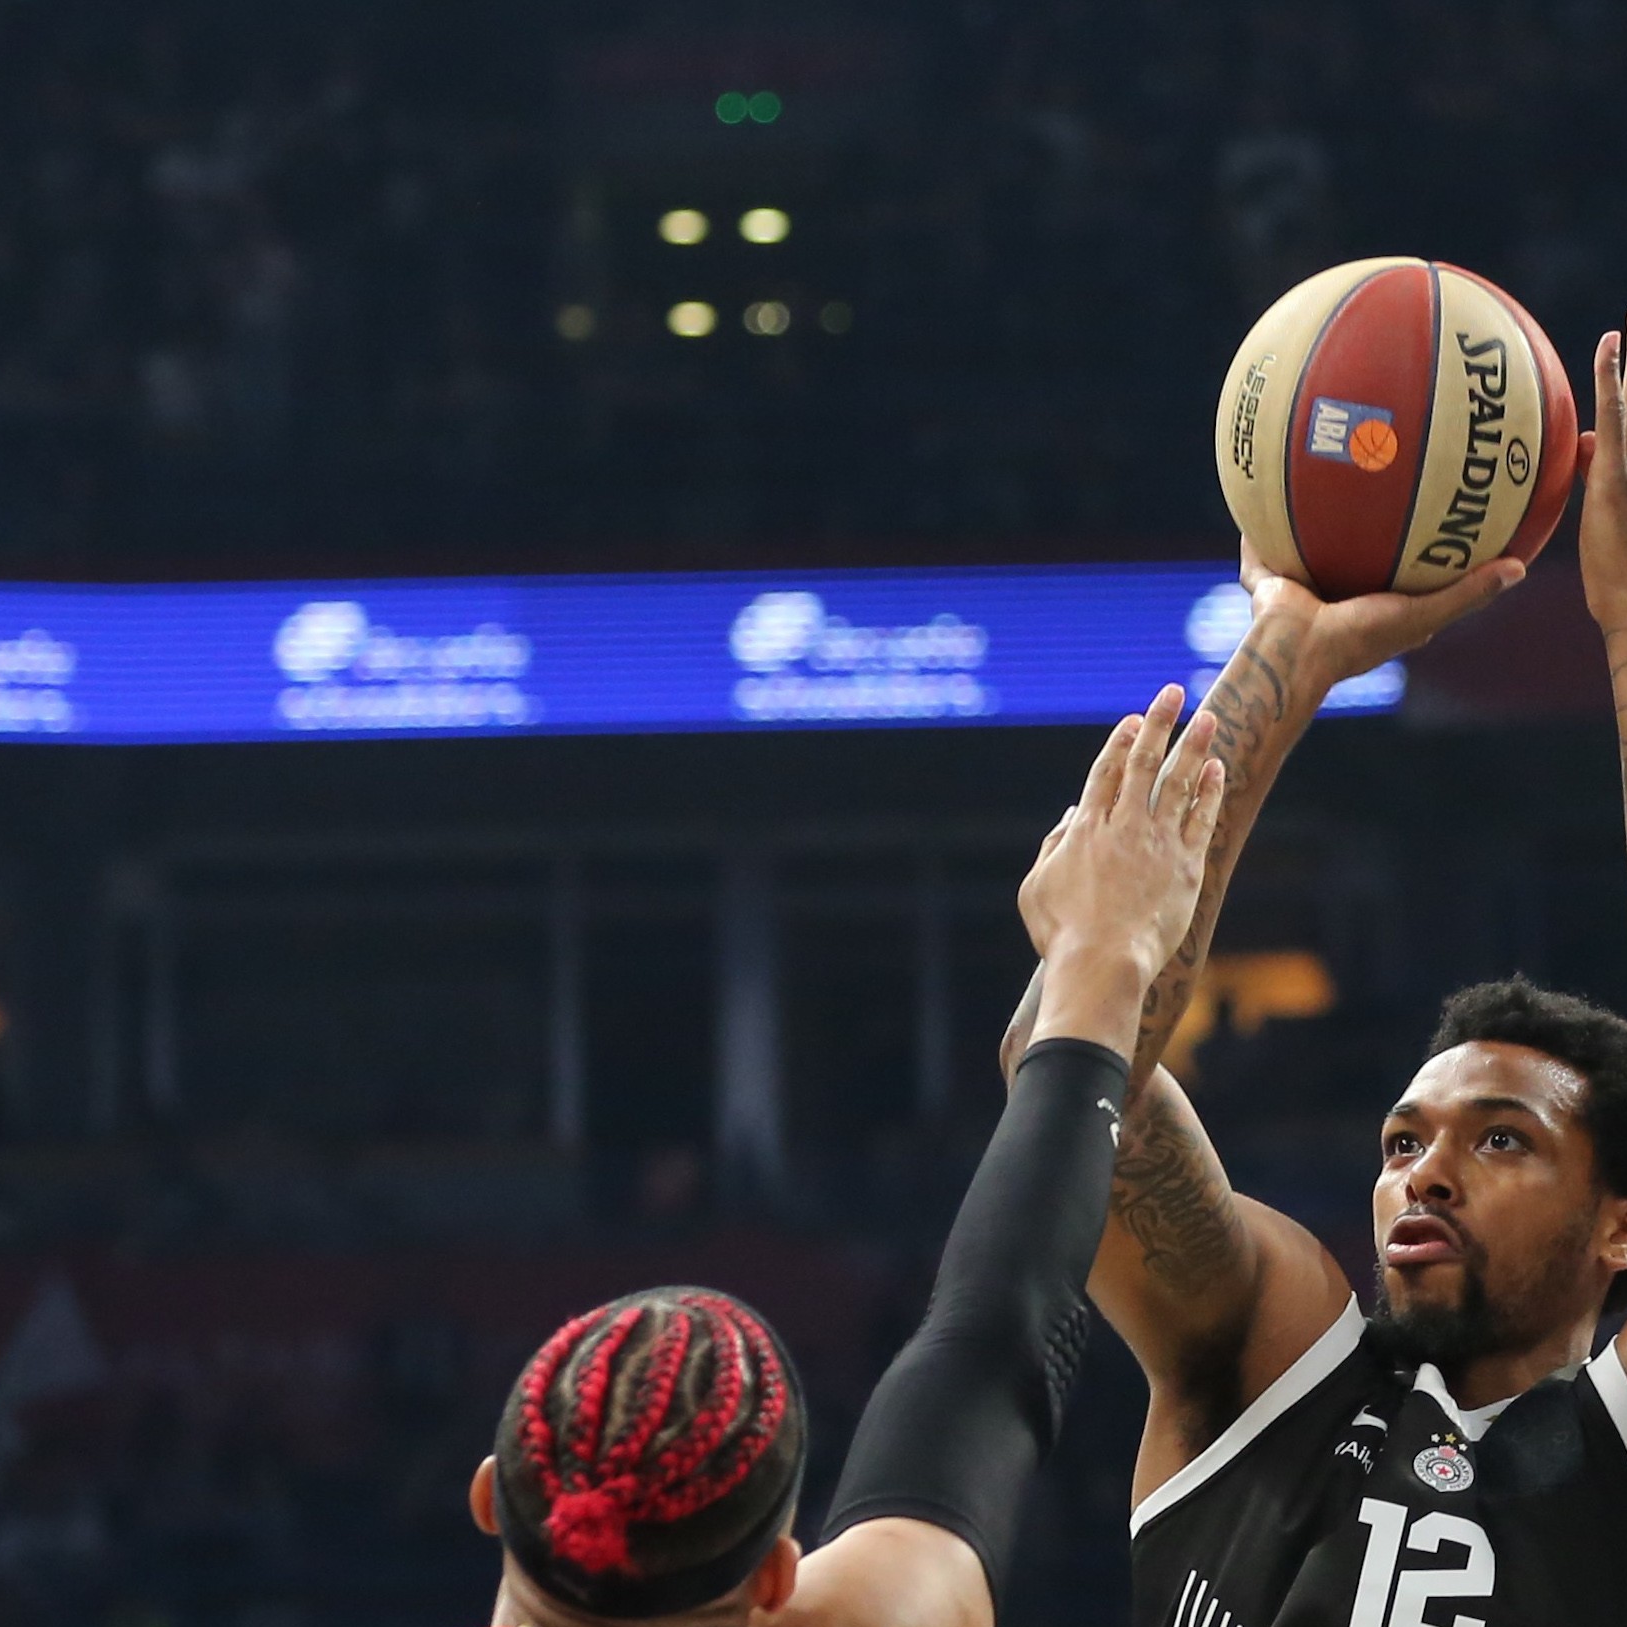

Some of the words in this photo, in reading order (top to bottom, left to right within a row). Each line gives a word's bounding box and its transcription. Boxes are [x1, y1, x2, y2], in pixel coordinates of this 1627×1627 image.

[1241, 354, 1277, 480] LEGACY
[1311, 403, 1350, 455] ABA
[1419, 332, 1508, 571] SPALDING
